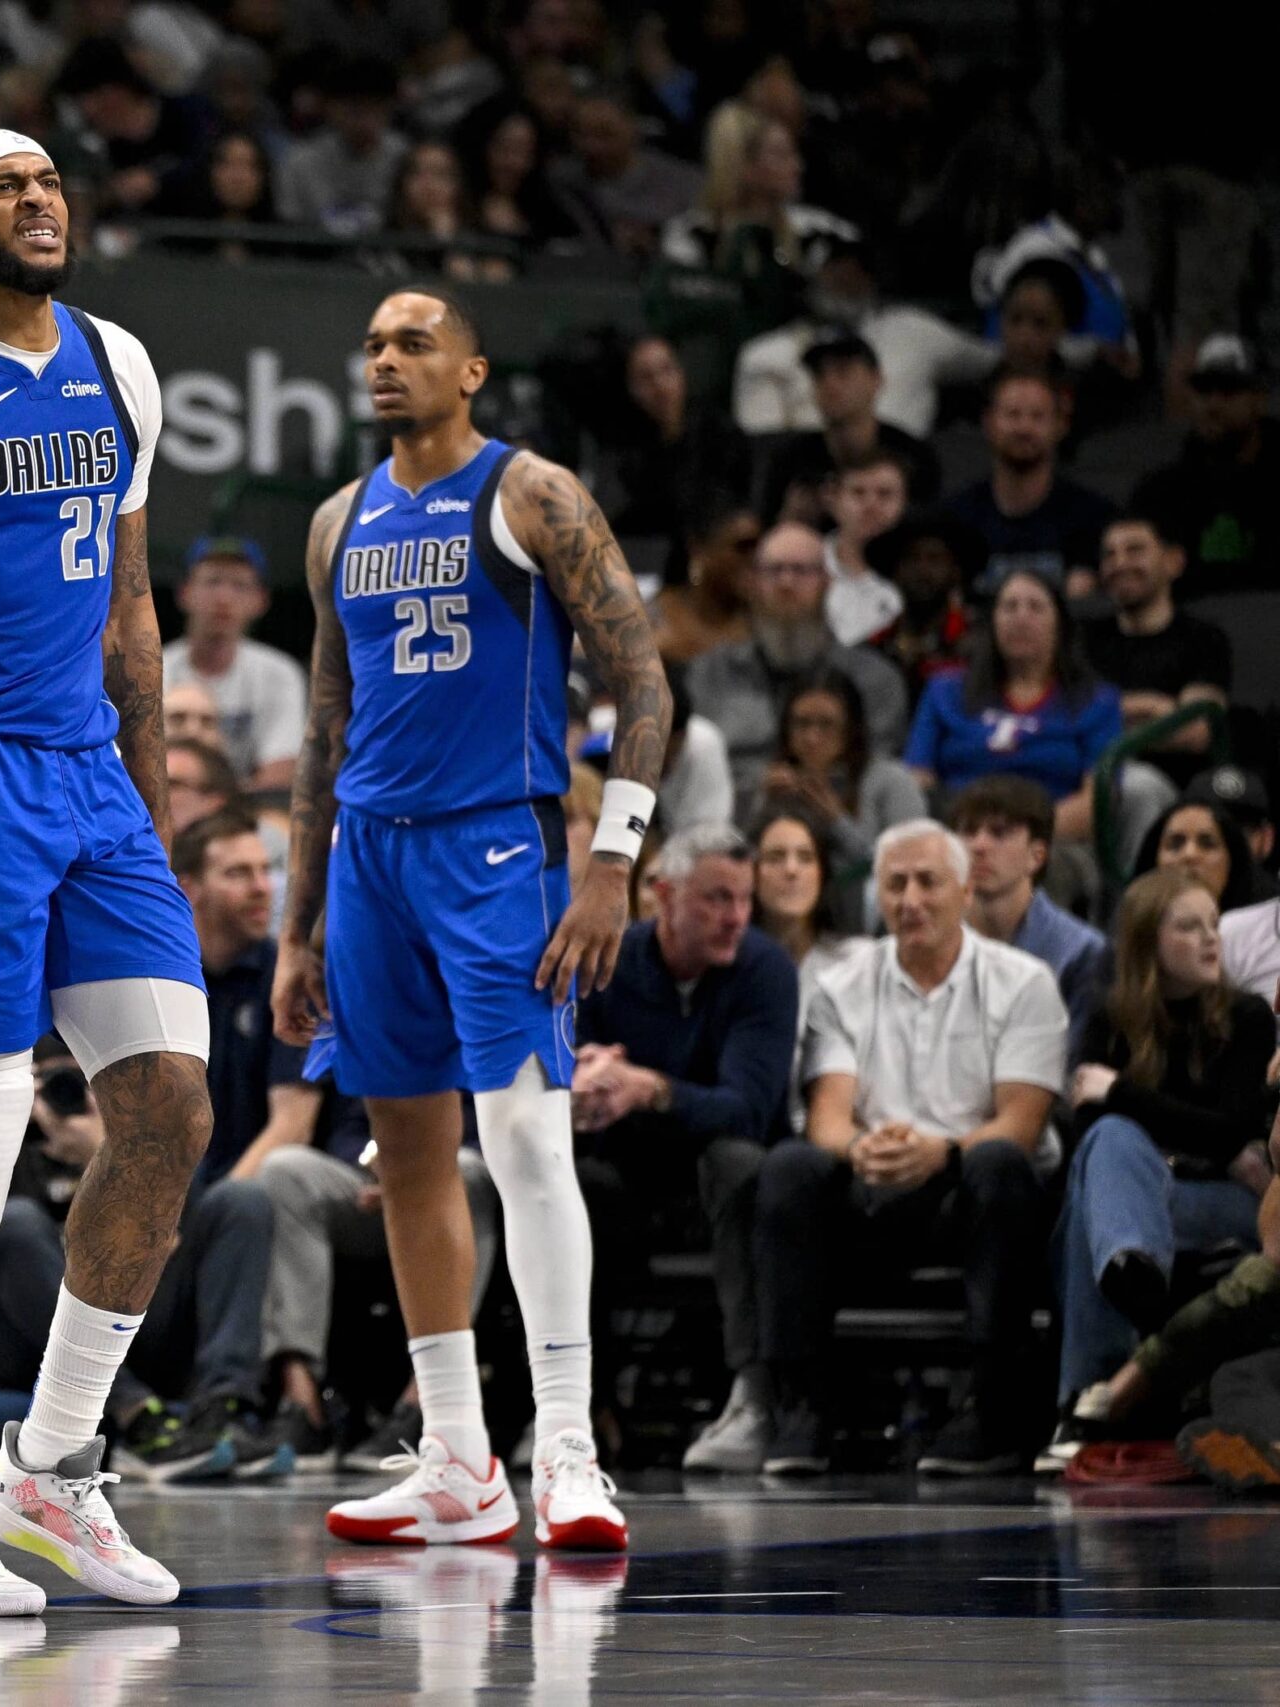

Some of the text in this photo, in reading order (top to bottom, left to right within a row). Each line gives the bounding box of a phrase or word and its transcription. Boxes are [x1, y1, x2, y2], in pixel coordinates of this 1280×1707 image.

[61, 380, 103, 398] chime
[59, 493, 117, 581] 21
[426, 498, 471, 514] chime
[342, 534, 471, 600] DALLAS
[393, 593, 472, 674] 25
